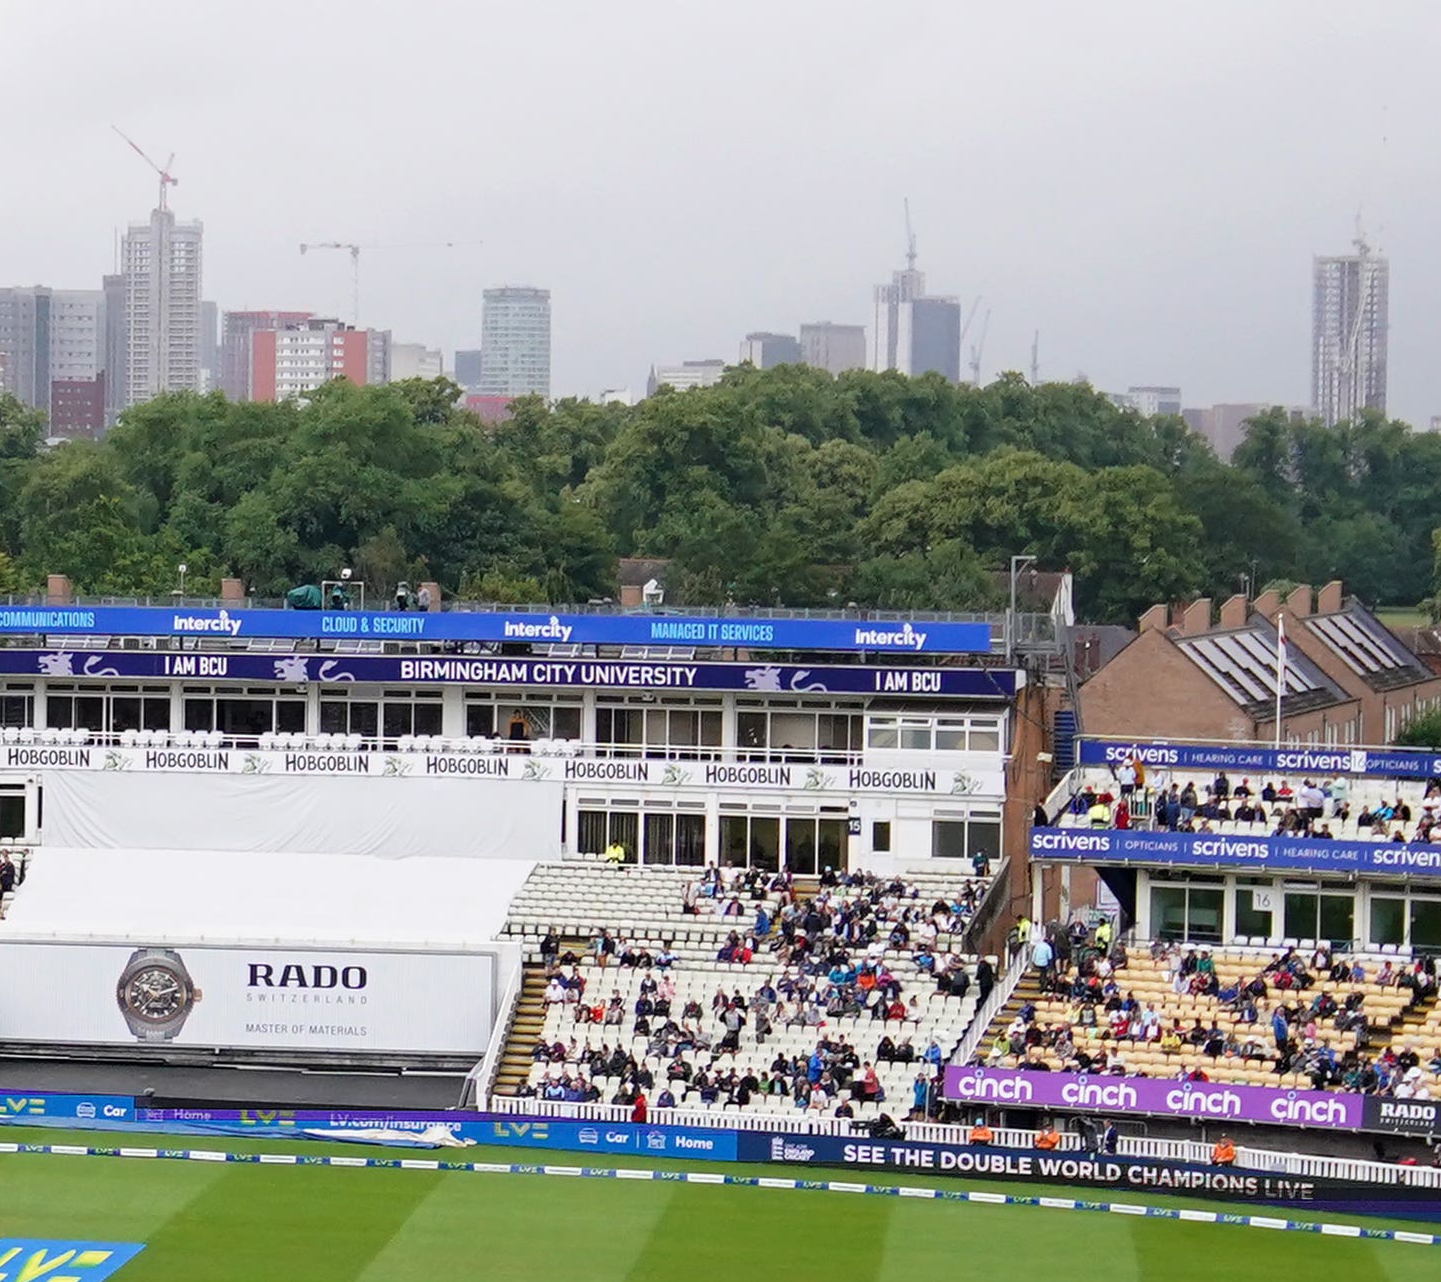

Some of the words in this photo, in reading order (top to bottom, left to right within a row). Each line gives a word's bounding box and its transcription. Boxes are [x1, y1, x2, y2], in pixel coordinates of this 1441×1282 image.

[174, 610, 242, 635] intercity
[322, 616, 358, 633] CLOUD
[360, 617, 369, 633] &
[373, 617, 425, 634] SECURITY
[505, 616, 572, 641] intercity
[651, 622, 705, 640] MANAGED
[707, 624, 718, 640] IT
[721, 625, 774, 642] SERVICES
[855, 623, 927, 650] intercity
[401, 660, 528, 683] BIRMINGHAM
[533, 663, 575, 685] CITY
[580, 664, 697, 687] UNIVERSITY
[875, 671, 880, 692] I
[883, 671, 908, 692] AM
[912, 671, 941, 693] BCU
[145, 751, 229, 770] HOBGOBLIN
[426, 757, 509, 777] HOBGOBLIN
[1105, 744, 1179, 763] scrivens
[1191, 752, 1235, 764] HEARING
[1237, 754, 1264, 766] CARE
[1276, 752, 1350, 771] scrivens
[848, 770, 937, 791] HOBGOBLIN
[849, 819, 860, 833] 15
[1032, 832, 1110, 852] scrivens
[1124, 840, 1178, 852] OPTICIANS
[1192, 839, 1269, 859] scrivens
[1283, 847, 1329, 860] HEARING
[1331, 850, 1359, 861] CARE
[1256, 893, 1270, 908] 16
[247, 962, 368, 990] RADO
[245, 993, 369, 1006] SWITZERLAND
[245, 1023, 287, 1035] MASTER
[290, 1024, 305, 1035] OF
[308, 1025, 368, 1037] MATERIALS
[959, 1070, 1032, 1102] cinch
[1061, 1074, 1137, 1110] cinch
[103, 1104, 127, 1118] Car
[1166, 1082, 1242, 1118] cinch
[1270, 1090, 1347, 1126] cinch
[1380, 1101, 1436, 1121] RADO
[605, 1130, 629, 1145] Car
[675, 1135, 714, 1151] Home
[843, 1144, 885, 1165] SEE
[891, 1146, 934, 1168] THE
[940, 1152, 1033, 1175] DOUBLE
[1039, 1158, 1121, 1183] WORLD
[1127, 1165, 1258, 1197] CHAMPIONS
